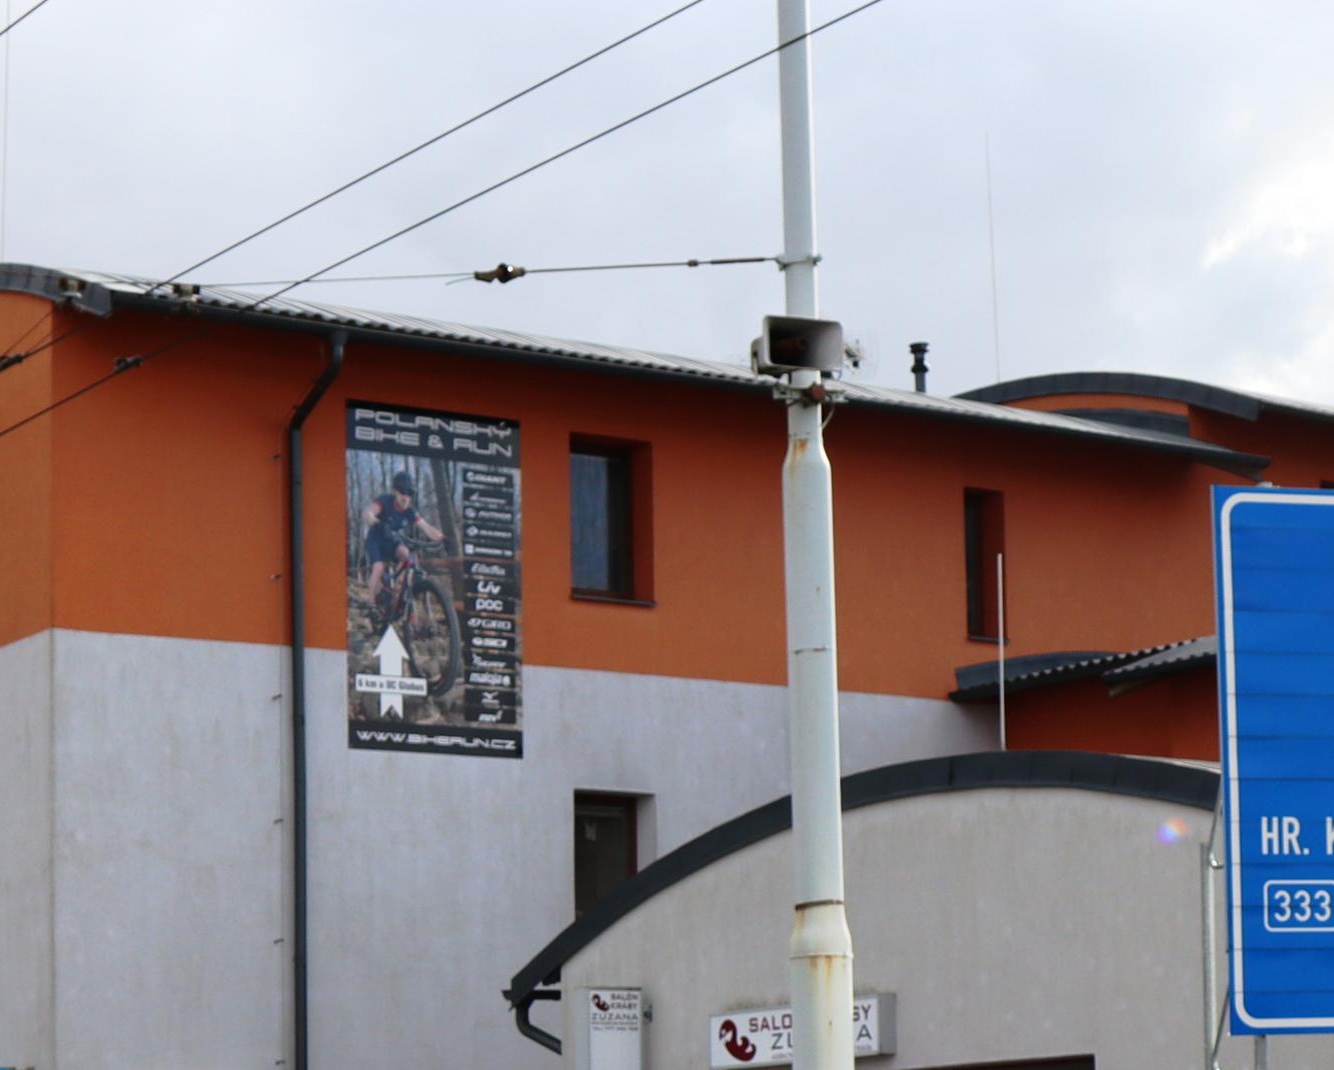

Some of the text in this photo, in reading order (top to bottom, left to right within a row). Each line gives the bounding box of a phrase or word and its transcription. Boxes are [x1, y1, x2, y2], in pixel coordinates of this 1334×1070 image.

[355, 408, 511, 439] POLANSKÝ
[355, 426, 512, 457] BIKE & RUN
[477, 580, 501, 595] Liv
[356, 730, 516, 750] WWW.BIKERUN.CZ
[1261, 815, 1310, 856] HR.
[1274, 890, 1332, 921] 333
[749, 1013, 793, 1033] SALO
